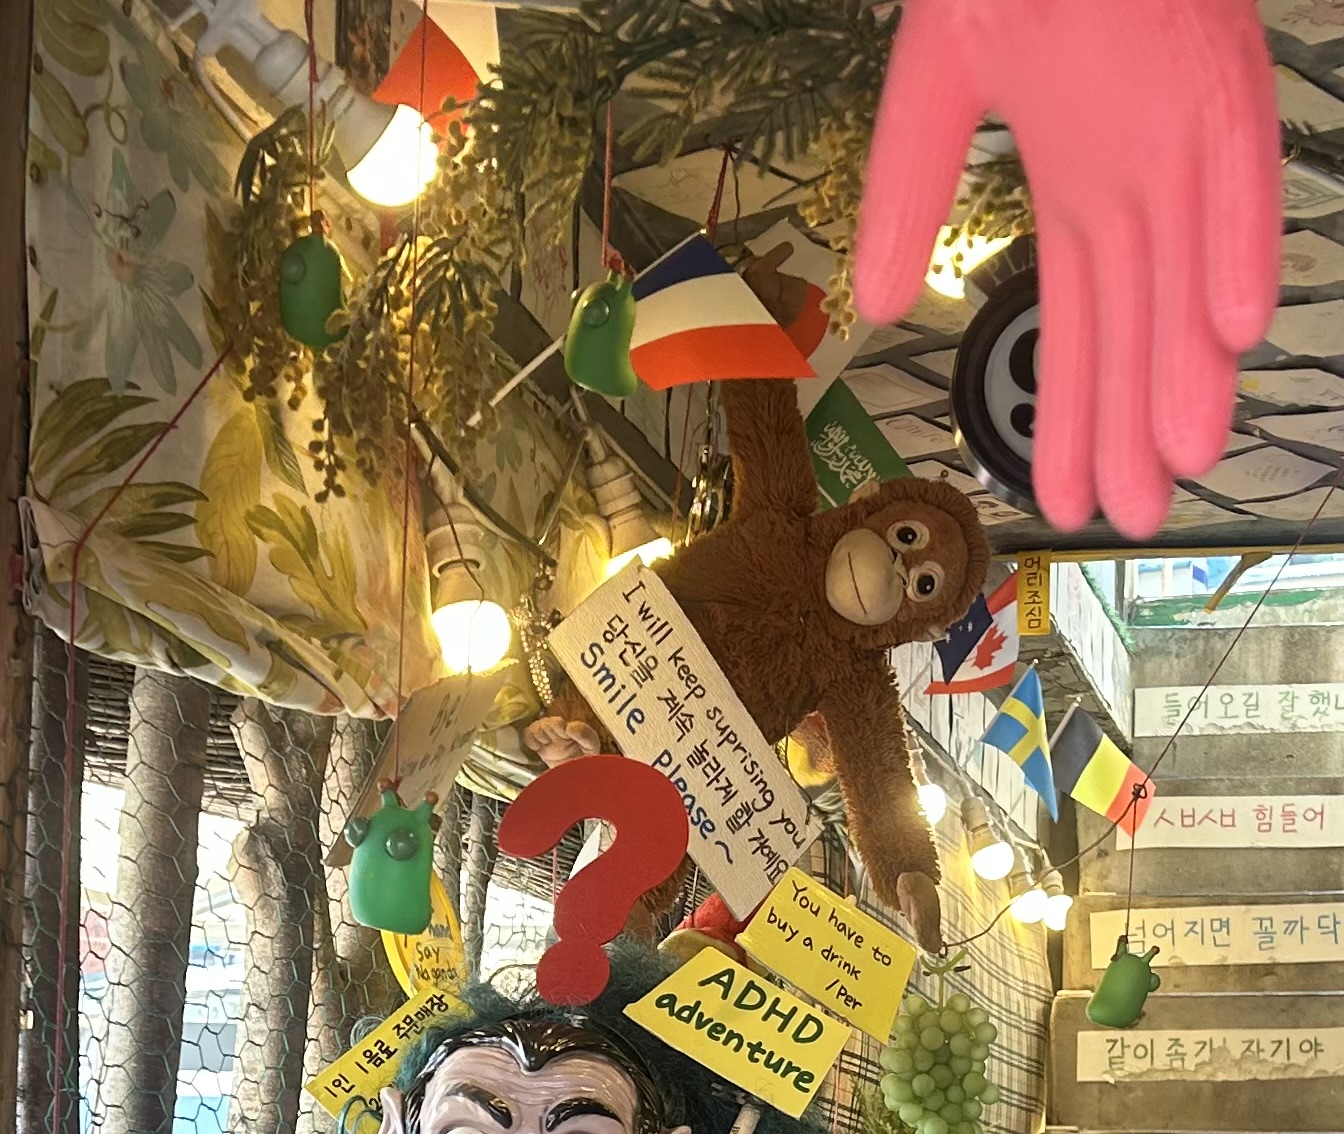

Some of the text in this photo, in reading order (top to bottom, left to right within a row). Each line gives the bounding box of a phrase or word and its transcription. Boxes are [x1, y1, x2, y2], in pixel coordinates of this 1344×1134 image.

[1023, 555, 1044, 630] 머리조심
[579, 640, 647, 737] Smile
[602, 613, 659, 689] 당신을
[656, 687, 695, 743] 계속
[685, 738, 740, 807] 놀라게
[725, 801, 754, 836] 할
[622, 580, 807, 850] I will keep suprising you
[1251, 803, 1326, 834] 힘들어
[767, 906, 862, 981] buy a drink
[791, 879, 893, 968] You have to
[1127, 911, 1342, 955] 넘어지면 꼴까닥
[654, 992, 816, 1094] adventure
[697, 967, 825, 1045] ADHD
